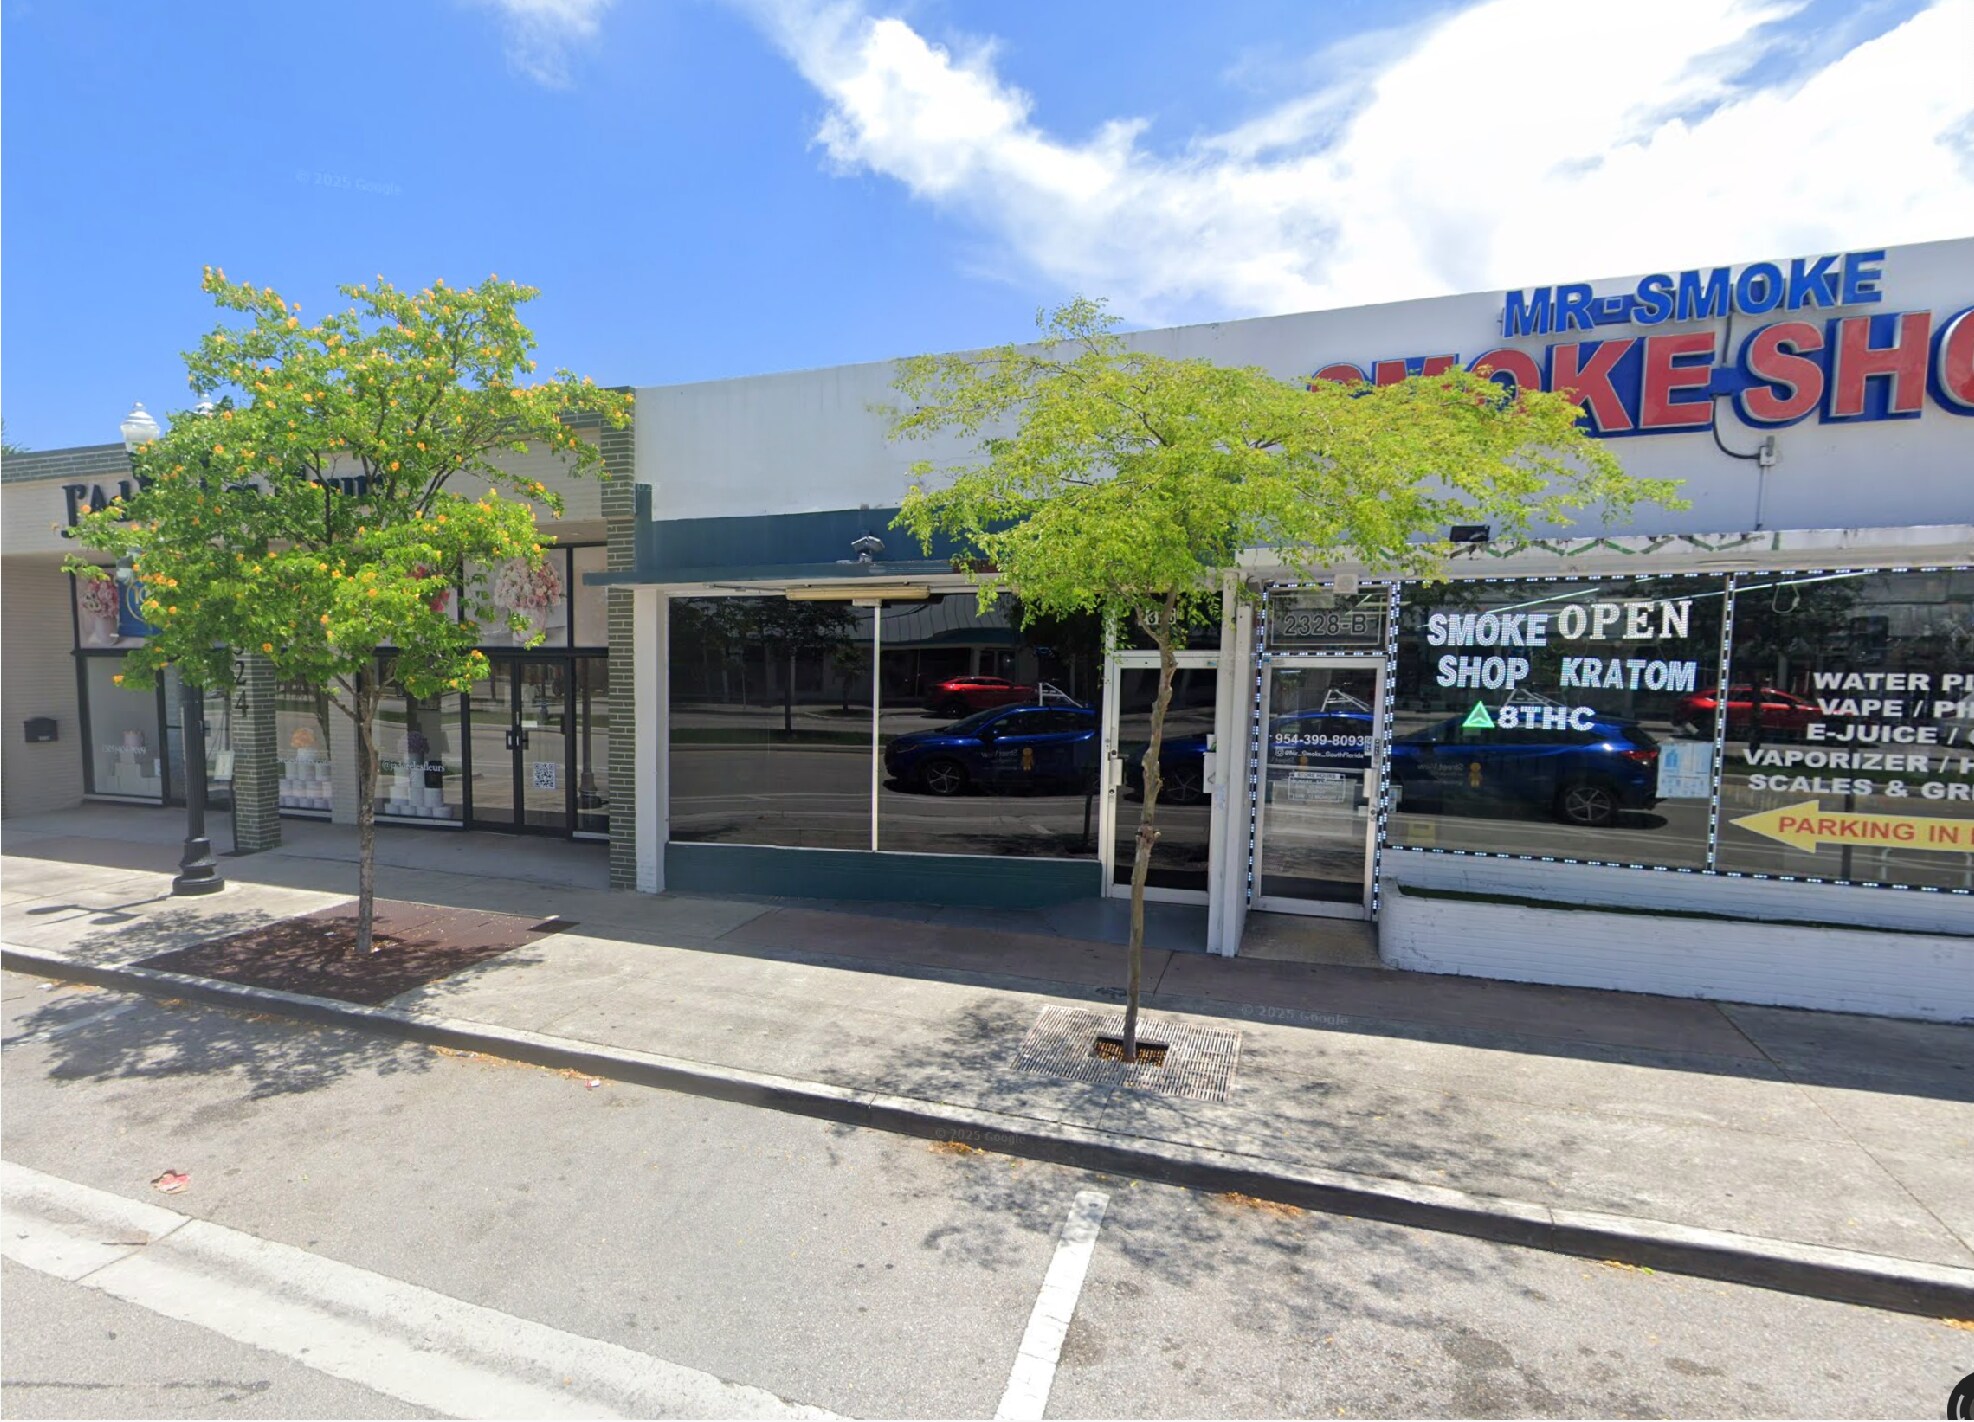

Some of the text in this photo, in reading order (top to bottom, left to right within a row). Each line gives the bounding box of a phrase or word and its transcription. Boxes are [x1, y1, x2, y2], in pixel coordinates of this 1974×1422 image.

[1502, 248, 1887, 339] MR-SMOKE
[1283, 613, 1367, 636] 2328-B
[1426, 611, 1548, 648] SMOKE
[1558, 600, 1692, 640] OPEN
[1436, 653, 1697, 692] SHOP KRATOM
[1813, 672, 1930, 691] WATER
[1817, 698, 1904, 717] VAPE
[1913, 699, 1924, 718] /
[1274, 733, 1365, 747] 954-399-8093
[1806, 723, 1938, 744] E-JUICE
[1946, 727, 1958, 745] /
[1743, 748, 1928, 773] VAPORIZER
[1938, 755, 1949, 774] /
[1748, 774, 1974, 801] SCALES & GR
[1777, 816, 1916, 841] PARKING
[1928, 825, 1960, 845] IN
